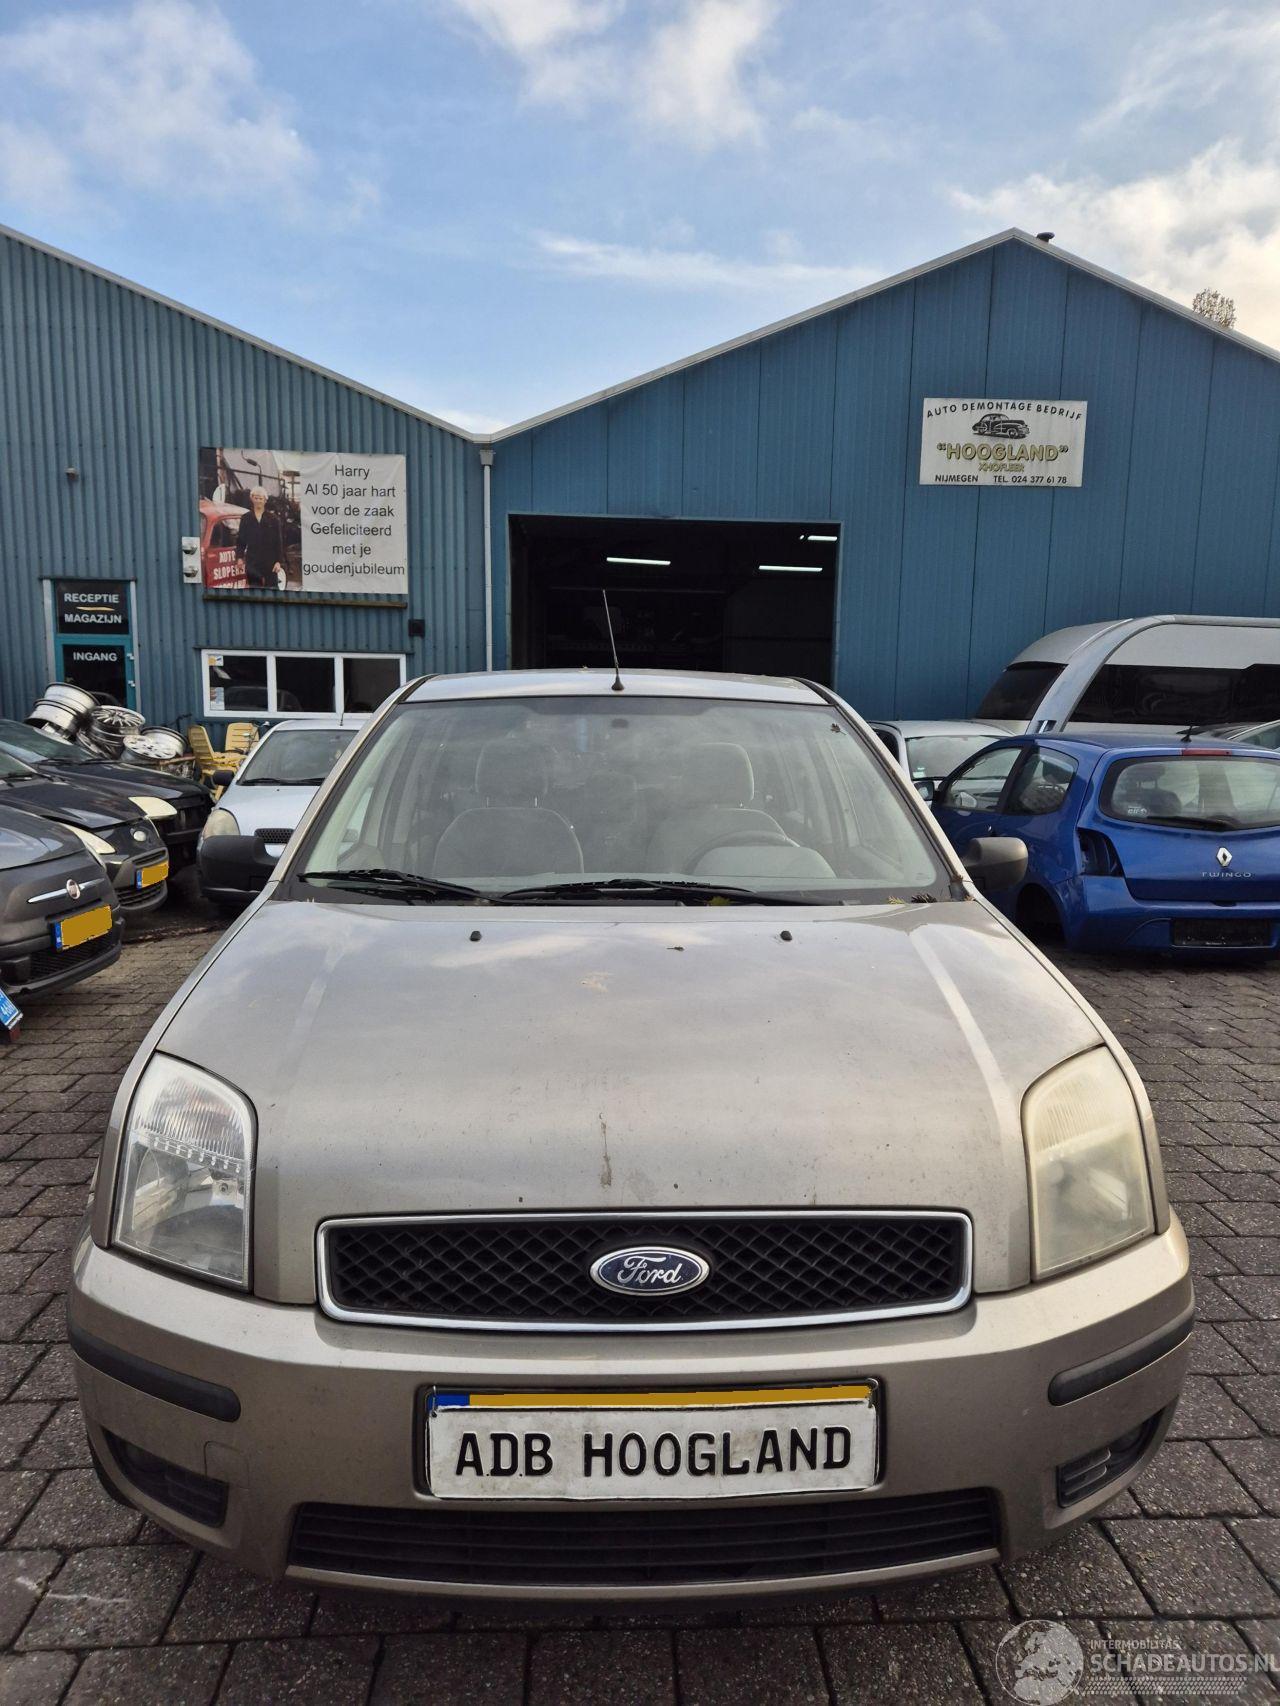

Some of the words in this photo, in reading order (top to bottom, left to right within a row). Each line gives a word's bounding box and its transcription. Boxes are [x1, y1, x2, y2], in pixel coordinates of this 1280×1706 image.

[927, 404, 957, 418] AUTO
[962, 402, 1031, 411] DEMONTAGE
[1036, 404, 1082, 420] BEDRIJF
[334, 464, 370, 480] Harry
[935, 474, 979, 483] NIJMEGEN
[1011, 475, 1027, 483] 024
[1030, 475, 1045, 484] 377
[1047, 475, 1055, 484] 61
[1058, 475, 1067, 484] 78
[305, 483, 318, 495] Al
[322, 484, 338, 496] 50
[341, 485, 367, 499] jaar
[371, 485, 396, 498] hart
[311, 505, 340, 516] voor
[343, 504, 360, 517] de
[363, 505, 395, 517] zaak
[310, 522, 392, 537] Gefeliciteerd
[332, 544, 356, 555] met
[358, 544, 372, 558] je
[303, 562, 405, 577] goudenjubileum
[64, 593, 119, 603] RECEPTIE
[64, 613, 122, 624] MAGAZIJN
[73, 652, 118, 661] INGANG
[617, 1255, 682, 1284] Ford
[583, 1426, 852, 1477] HOOGLAND
